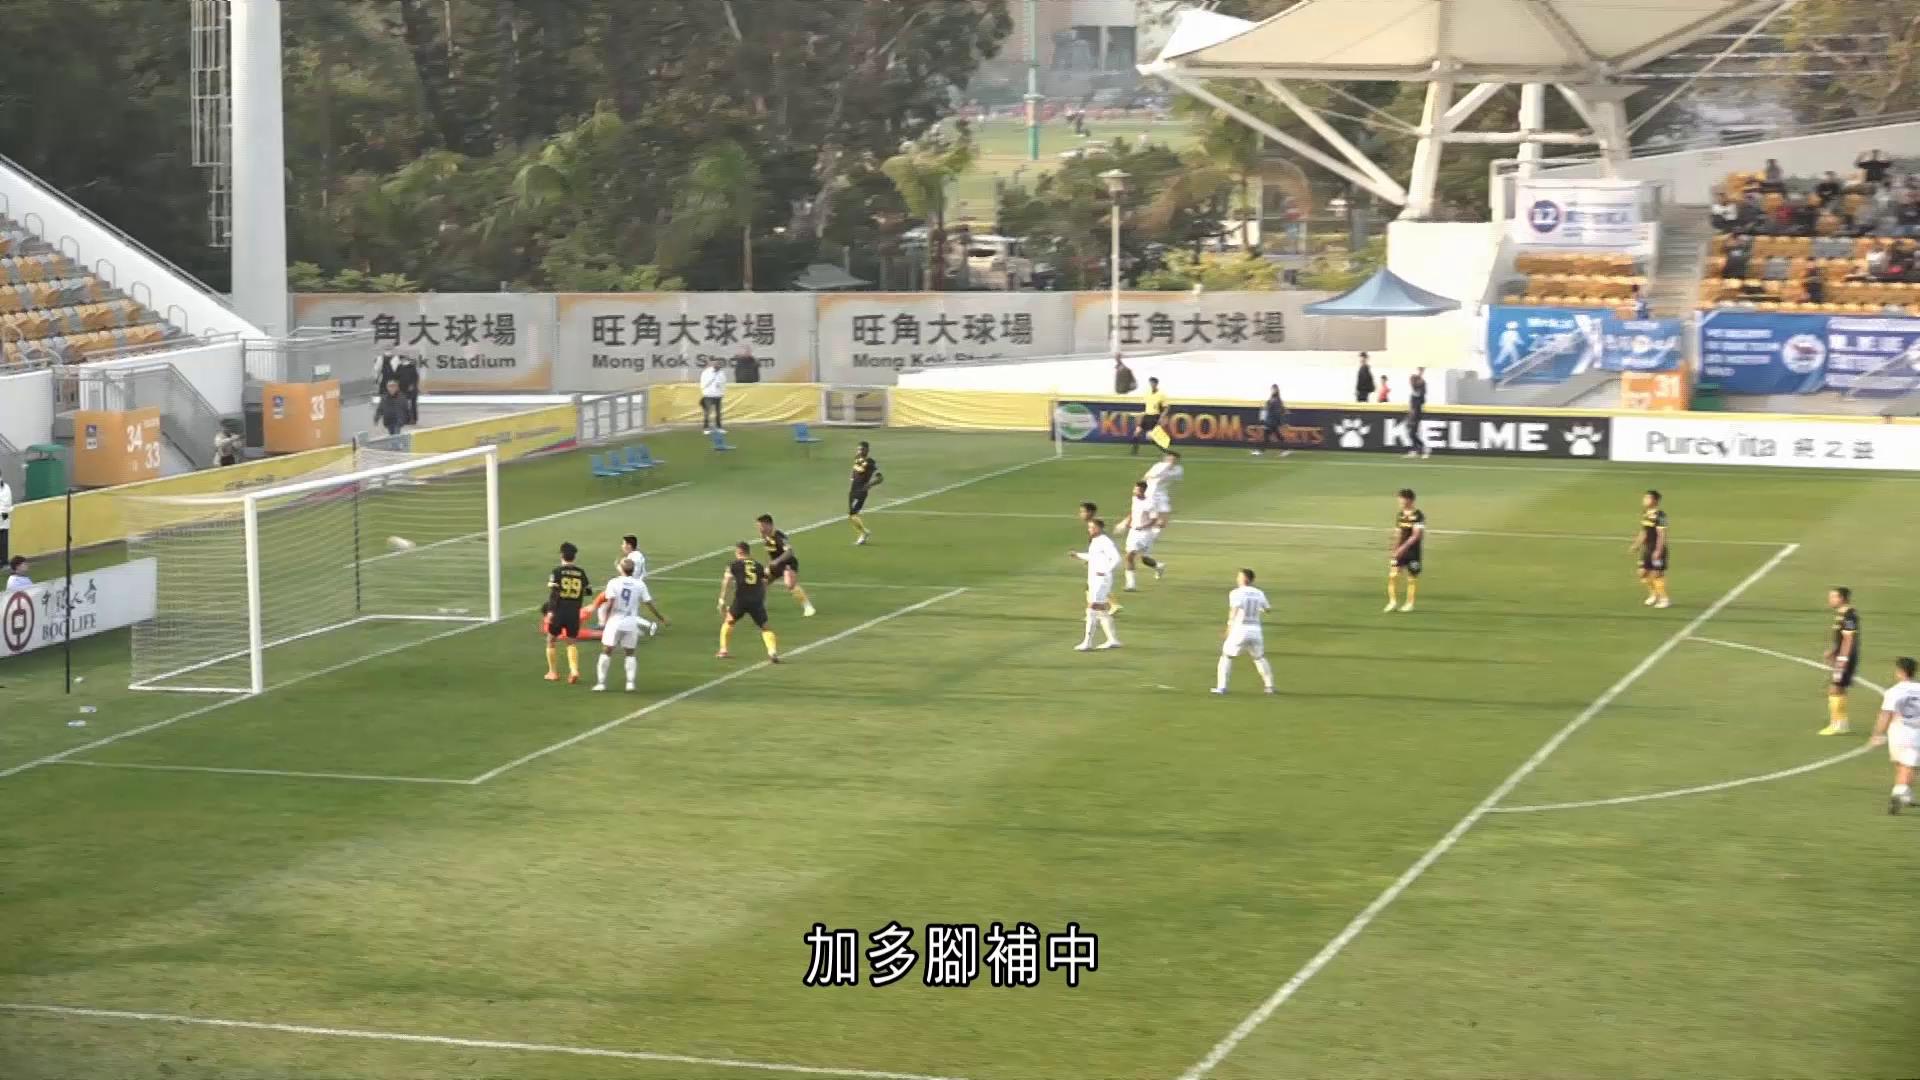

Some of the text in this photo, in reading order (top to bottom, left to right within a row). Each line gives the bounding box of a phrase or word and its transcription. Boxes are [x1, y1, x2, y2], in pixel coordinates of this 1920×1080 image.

[592, 312, 776, 346] 旺角大球場
[853, 312, 1034, 346] 旺角大球場
[436, 354, 516, 369] Stadium
[592, 354, 645, 372] Mong
[652, 354, 689, 369] Kok
[853, 354, 905, 371] Mong
[127, 422, 143, 453] 34
[1100, 408, 1243, 441] KITOOM
[1384, 418, 1549, 451] KELME
[744, 559, 758, 585] 5
[561, 577, 582, 600] 99
[621, 587, 632, 607] 9
